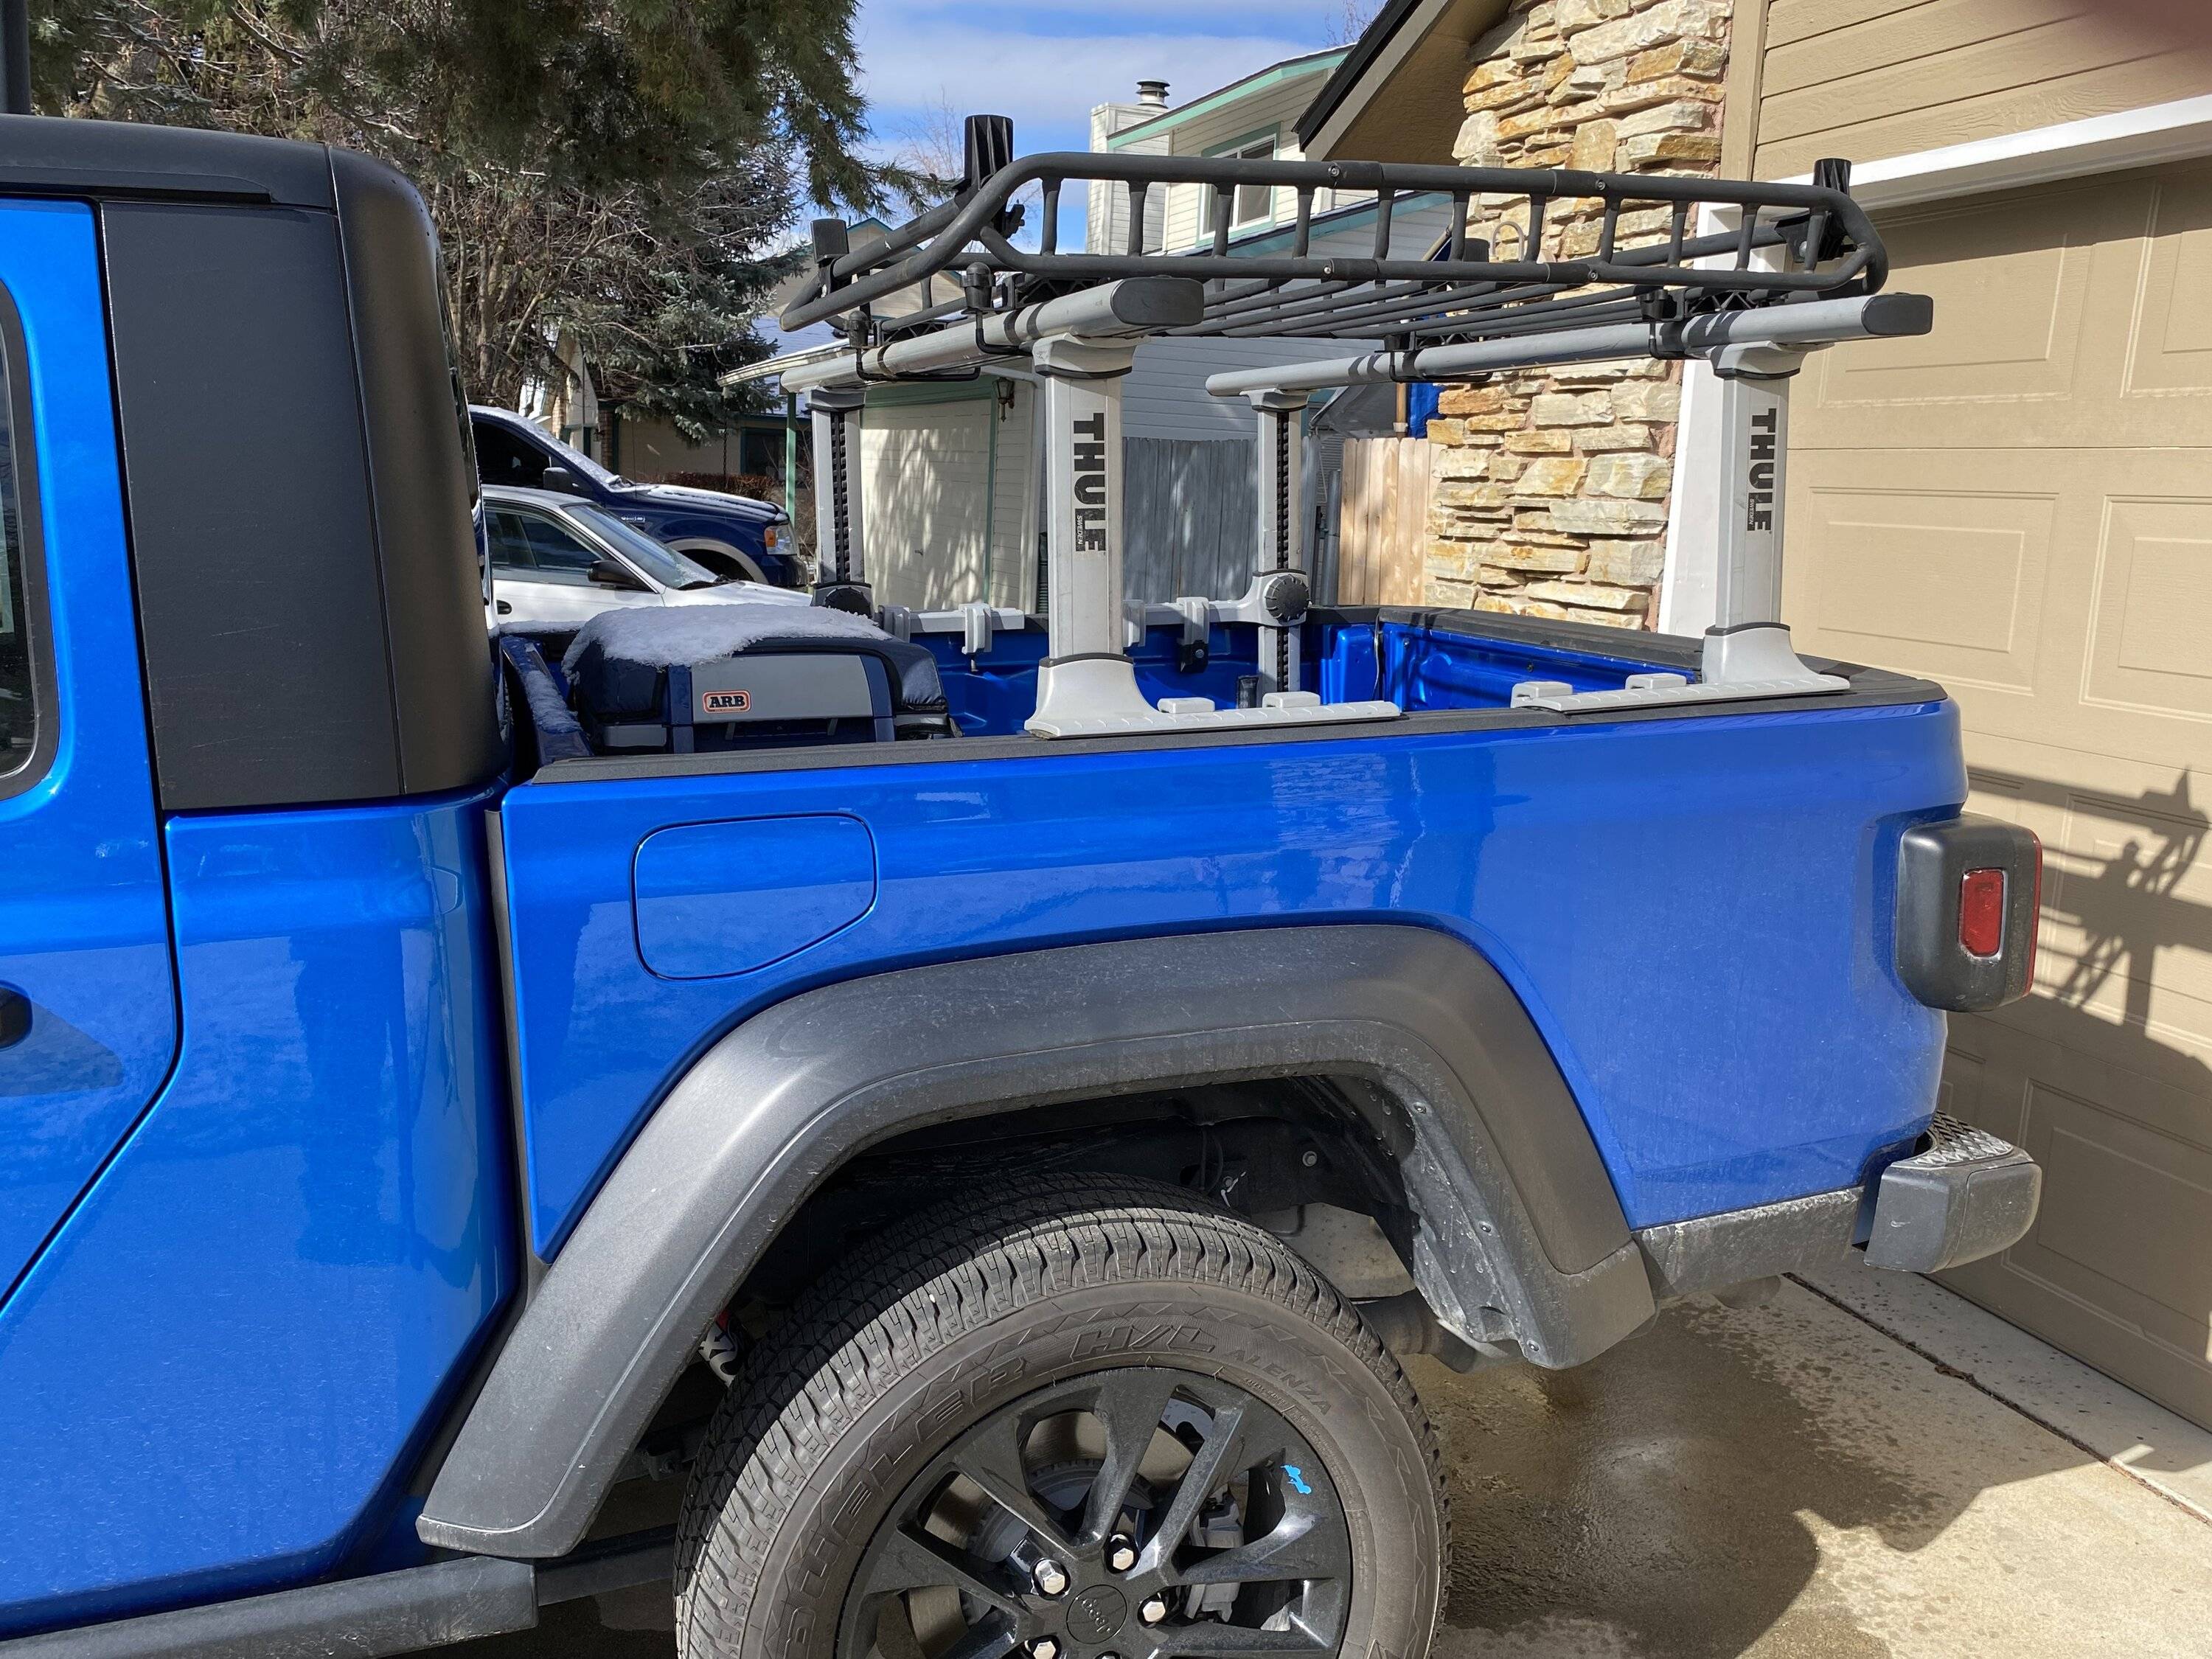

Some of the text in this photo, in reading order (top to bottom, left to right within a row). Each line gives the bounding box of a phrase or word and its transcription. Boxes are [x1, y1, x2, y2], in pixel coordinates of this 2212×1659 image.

[1074, 413, 1106, 552] THULE
[1747, 408, 1777, 532] THULE
[709, 695, 745, 708] ARB
[1221, 1349, 1331, 1415] ALENZA
[1081, 1599, 1111, 1632] Jeep
